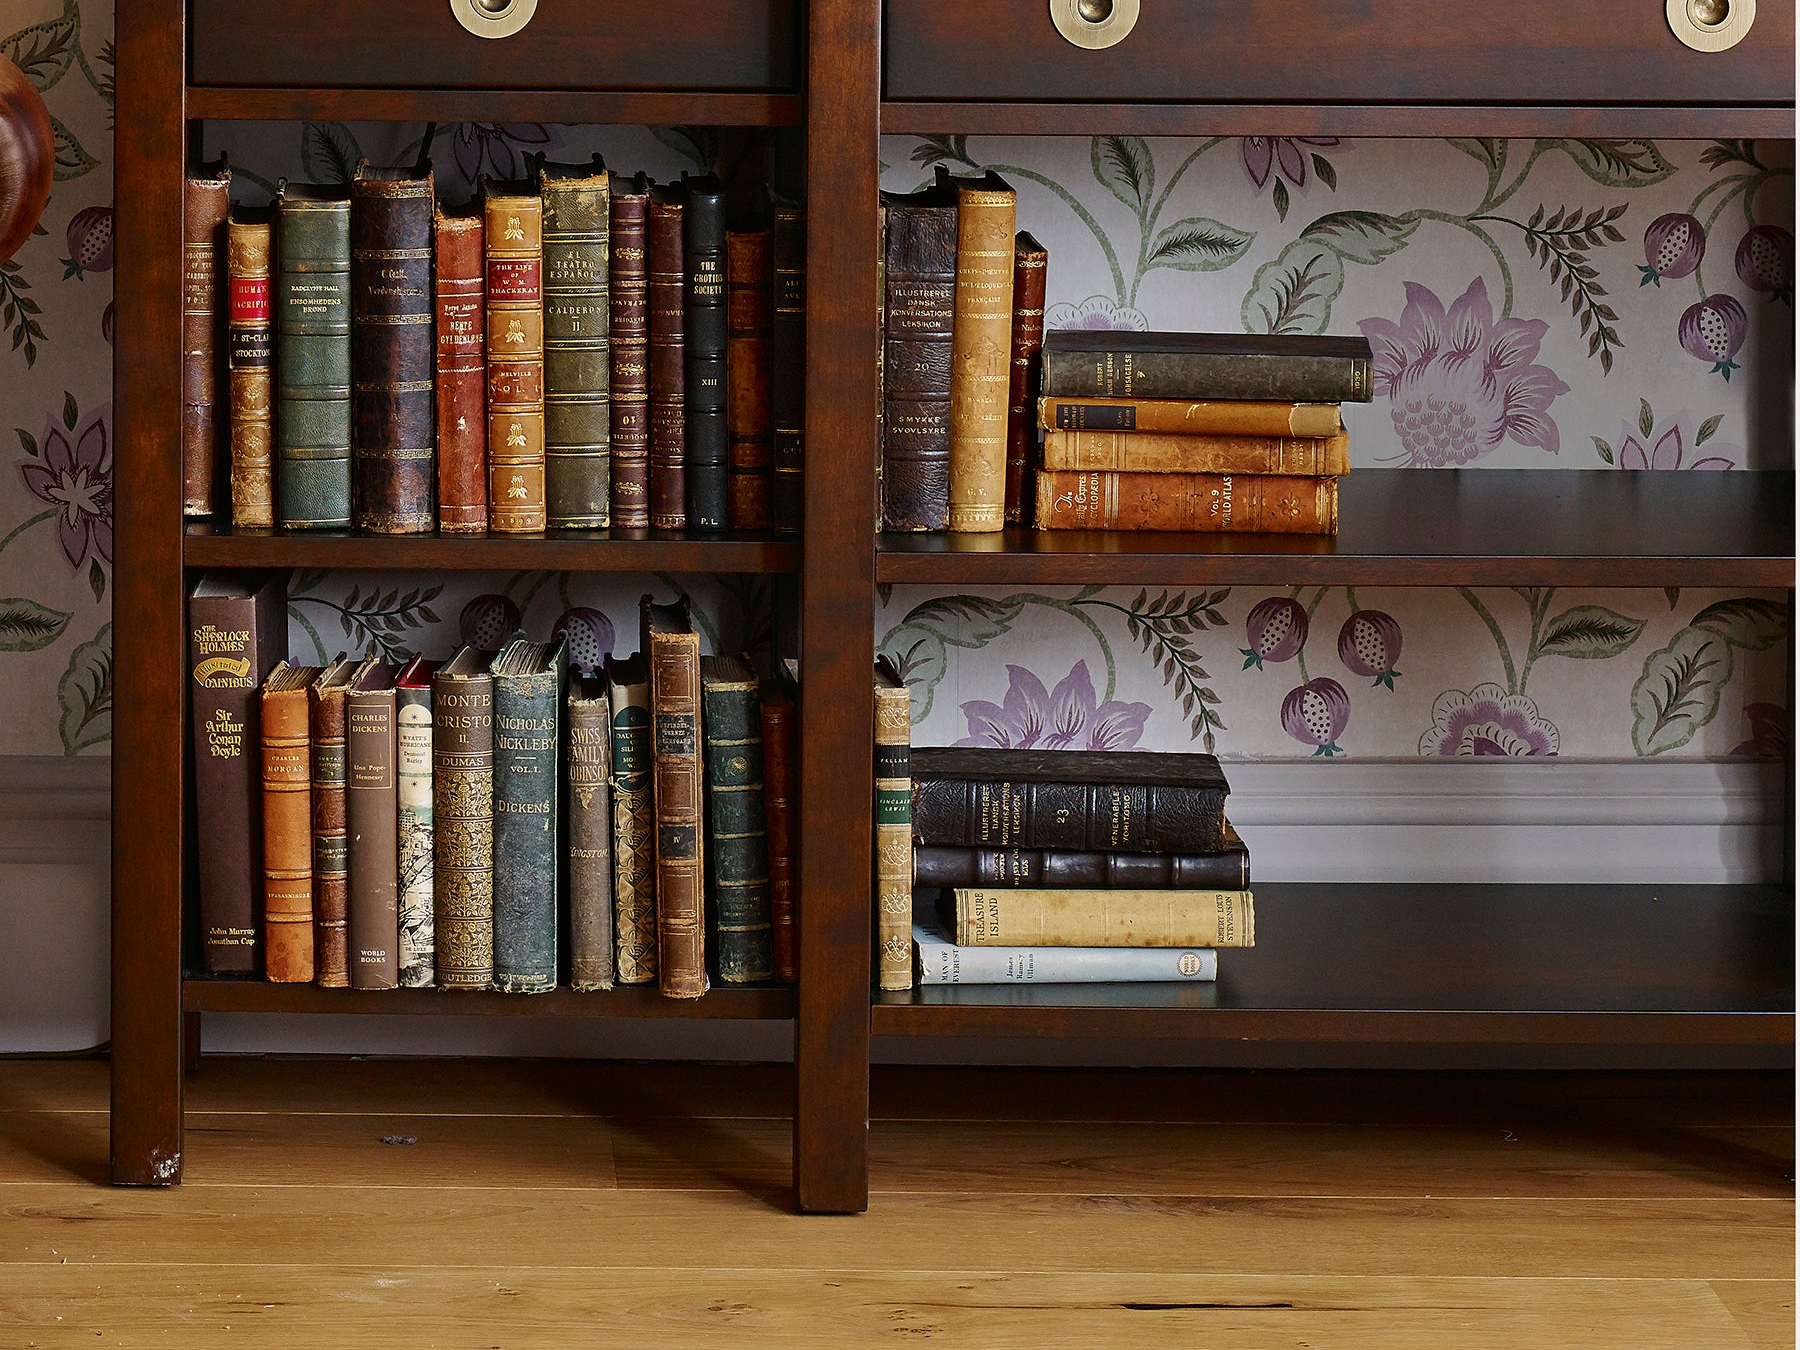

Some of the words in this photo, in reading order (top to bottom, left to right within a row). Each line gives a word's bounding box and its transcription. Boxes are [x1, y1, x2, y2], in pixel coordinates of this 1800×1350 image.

[567, 251, 581, 259] EL
[515, 263, 533, 271] LIFE
[556, 260, 596, 269] TEATRO
[700, 261, 716, 271] THE
[239, 285, 267, 294] HUMAN
[693, 285, 722, 295] SOCIETY
[548, 306, 602, 315] CALDERON
[890, 309, 953, 317] KONVERSATIONS
[614, 316, 645, 324] HISTOIRE
[902, 320, 941, 328] LEKSIKON
[235, 349, 270, 358] STOCKTON
[914, 362, 930, 372] 20
[1106, 352, 1114, 377] BENSON
[1124, 353, 1132, 396] FORSAGELSE
[701, 378, 718, 386] XIII
[1106, 377, 1114, 395] HUGH
[490, 384, 525, 393] VOL.
[622, 415, 637, 425] 10
[898, 416, 941, 424] SMYKKE
[1211, 489, 1220, 497] 9
[1222, 476, 1233, 500] ATLAS
[1054, 491, 1073, 513] The
[700, 517, 708, 525] P.
[201, 624, 216, 632] THE
[193, 629, 250, 643] SHERLOCK
[200, 641, 245, 655] HOLMES
[197, 660, 243, 677] Illustrated
[205, 677, 254, 688] OMNIBUS
[436, 694, 491, 707] MONTE
[215, 708, 233, 722] Sir
[351, 714, 388, 722] CHARLES
[205, 720, 244, 734] Arthur
[436, 715, 492, 729] CRISTO
[496, 714, 555, 730] NICHOLAS
[352, 725, 388, 733] DICKENS
[208, 732, 242, 746] Conan
[459, 734, 470, 743] II.
[571, 727, 600, 745] SWISS
[495, 734, 557, 751] NICKLEBY
[210, 744, 241, 759] Doyle
[442, 757, 485, 767] DUMAS
[267, 764, 304, 773] MORGAN
[368, 764, 386, 773] Pope-
[355, 773, 384, 782] Hennessy
[498, 799, 550, 813] DICKENS
[1013, 794, 1021, 834] LEKSIKON
[1056, 808, 1070, 824] 23
[1111, 790, 1120, 846] VENERABILE
[1122, 794, 1131, 843] YORITOMO
[1216, 894, 1224, 913] LOUIS
[975, 892, 985, 943] TREASURE
[989, 897, 999, 937] ISLAND
[1225, 895, 1234, 942] STEVENSON
[209, 927, 227, 935] John
[228, 927, 255, 936] Murray
[1217, 915, 1225, 943] ROBERT
[207, 937, 239, 945] Jonathan
[941, 950, 949, 962] OF
[952, 949, 960, 983] EVEREST
[1006, 956, 1014, 978] James
[1016, 954, 1025, 979] Ramsey
[440, 973, 493, 983] OUTLEDGE
[941, 965, 949, 981] MAN
